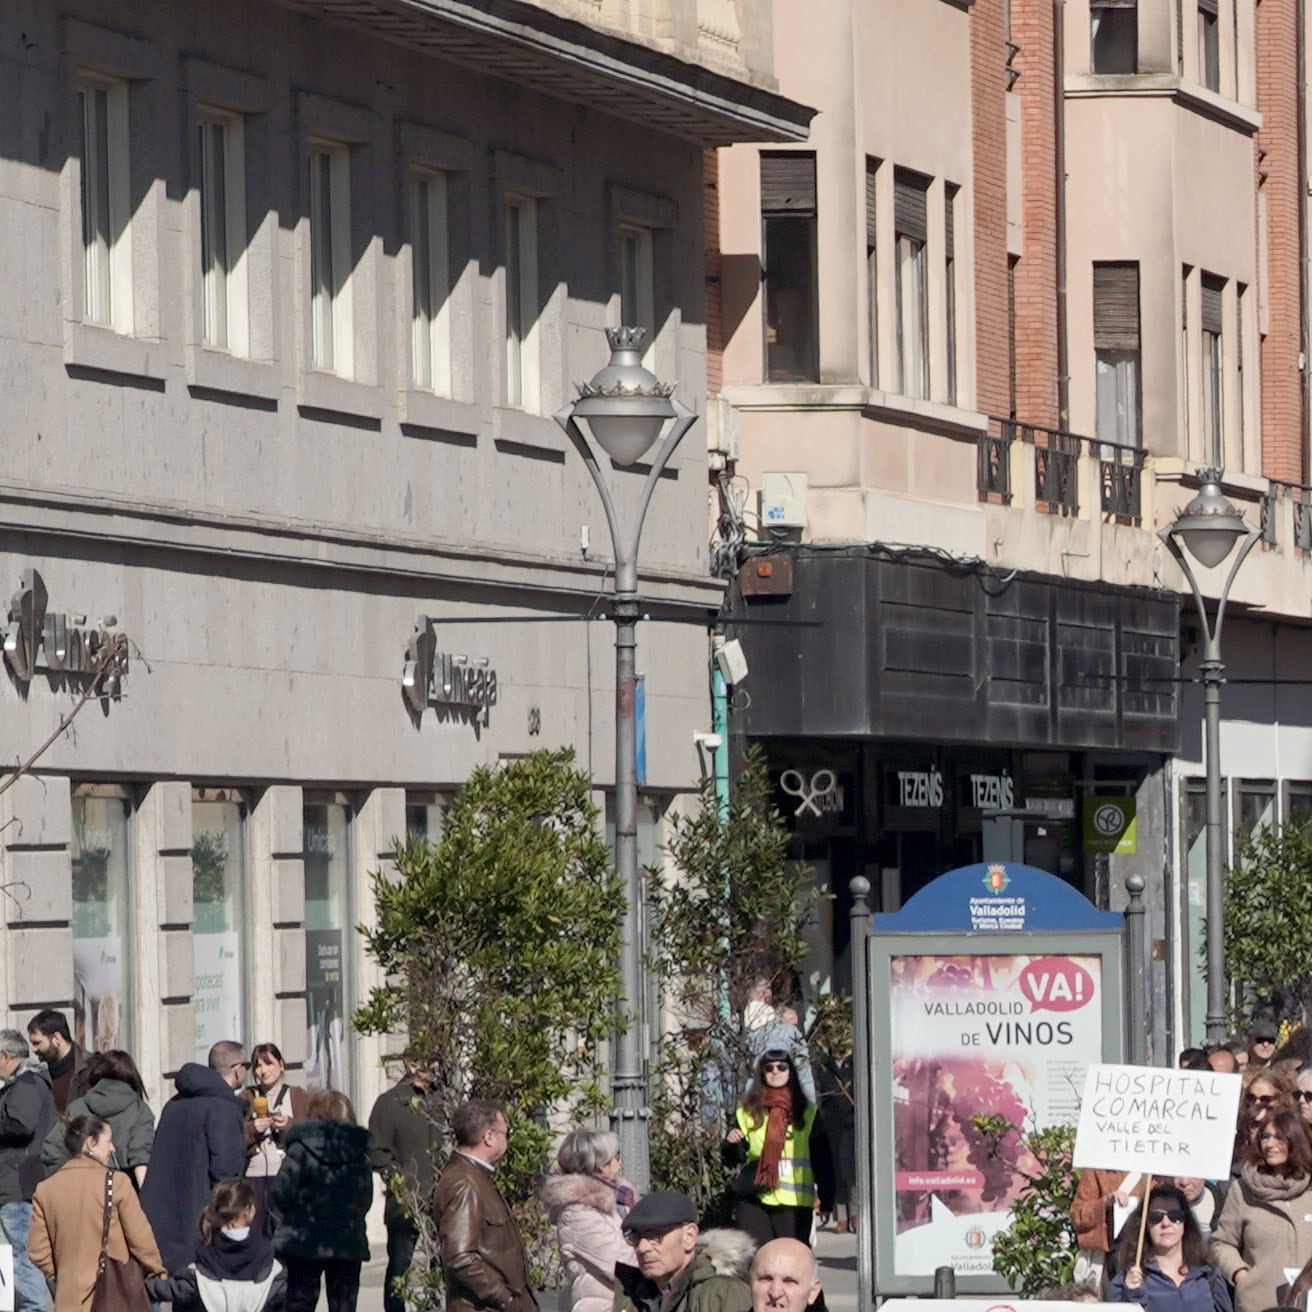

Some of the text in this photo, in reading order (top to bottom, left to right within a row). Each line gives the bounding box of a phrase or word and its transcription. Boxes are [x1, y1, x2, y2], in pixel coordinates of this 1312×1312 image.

[969, 905, 1026, 917] Valladolid
[1026, 972, 1083, 1002] VA!
[924, 1002, 1024, 1016] VALLADOLID
[961, 1021, 1074, 1046] DE VINOS
[1091, 1071, 1222, 1096] HOSPITAL
[1092, 1096, 1219, 1121] COMARCAL
[1095, 1121, 1141, 1135] VALLE
[1108, 1139, 1192, 1155] TIETAR
[908, 1175, 977, 1186] info.valladolid.es
